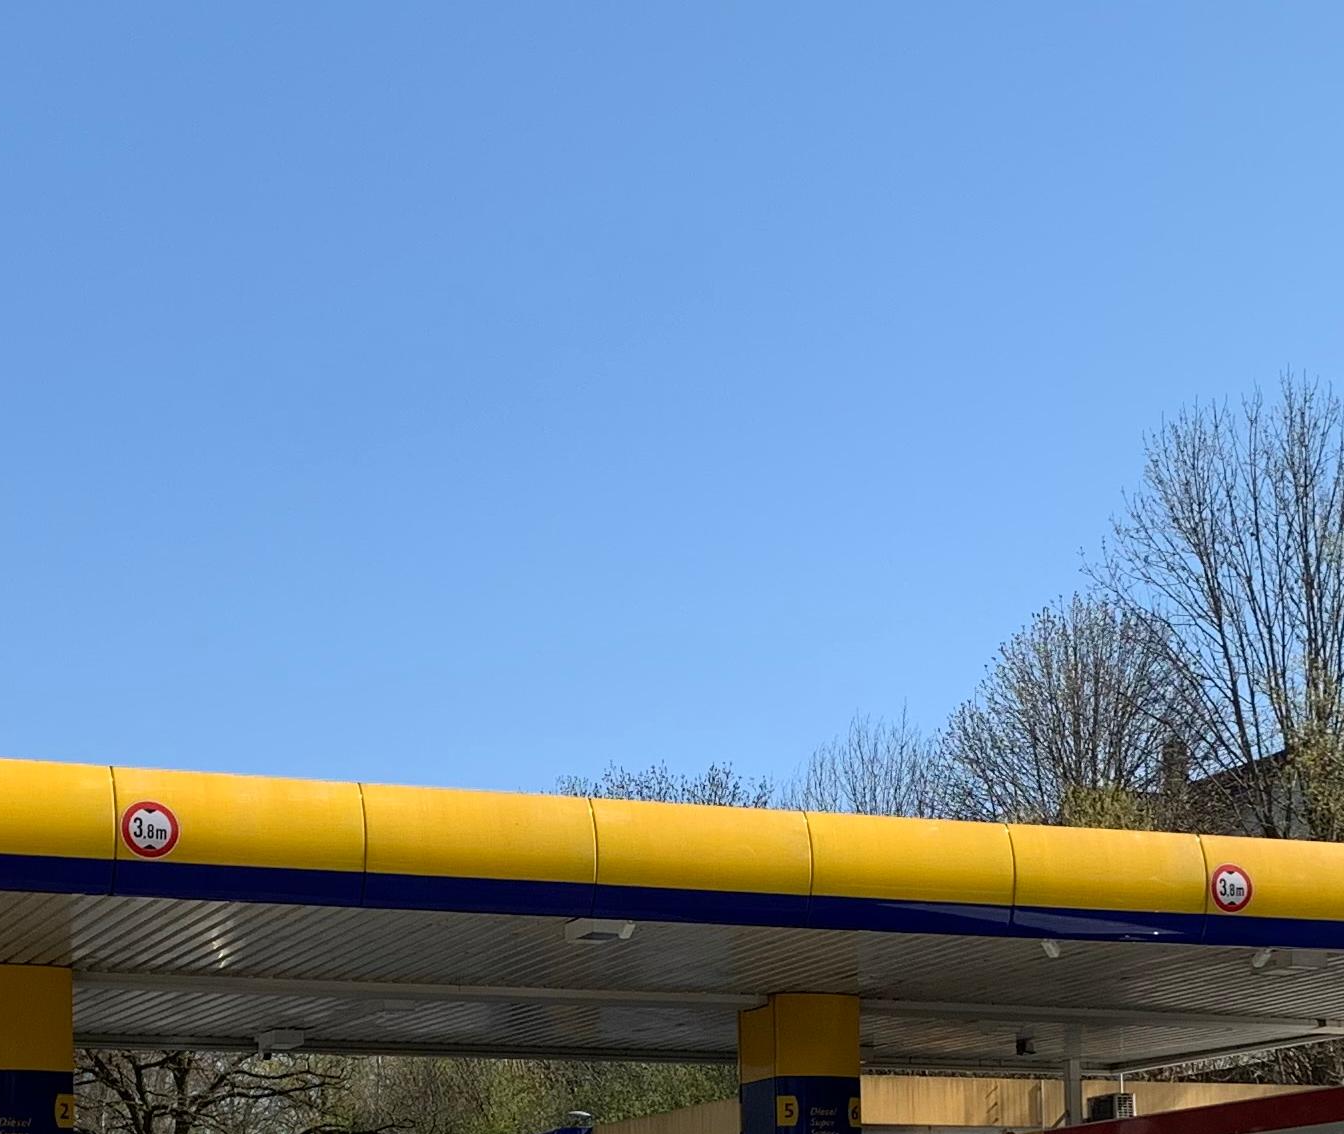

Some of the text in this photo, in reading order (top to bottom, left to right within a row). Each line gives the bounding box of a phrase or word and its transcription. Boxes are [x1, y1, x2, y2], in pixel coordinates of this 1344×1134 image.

[60, 1103, 69, 1119] 2
[784, 1103, 794, 1118] 5
[810, 1106, 838, 1117] Diesel
[852, 1105, 859, 1120] 6
[810, 1117, 836, 1128] Super
